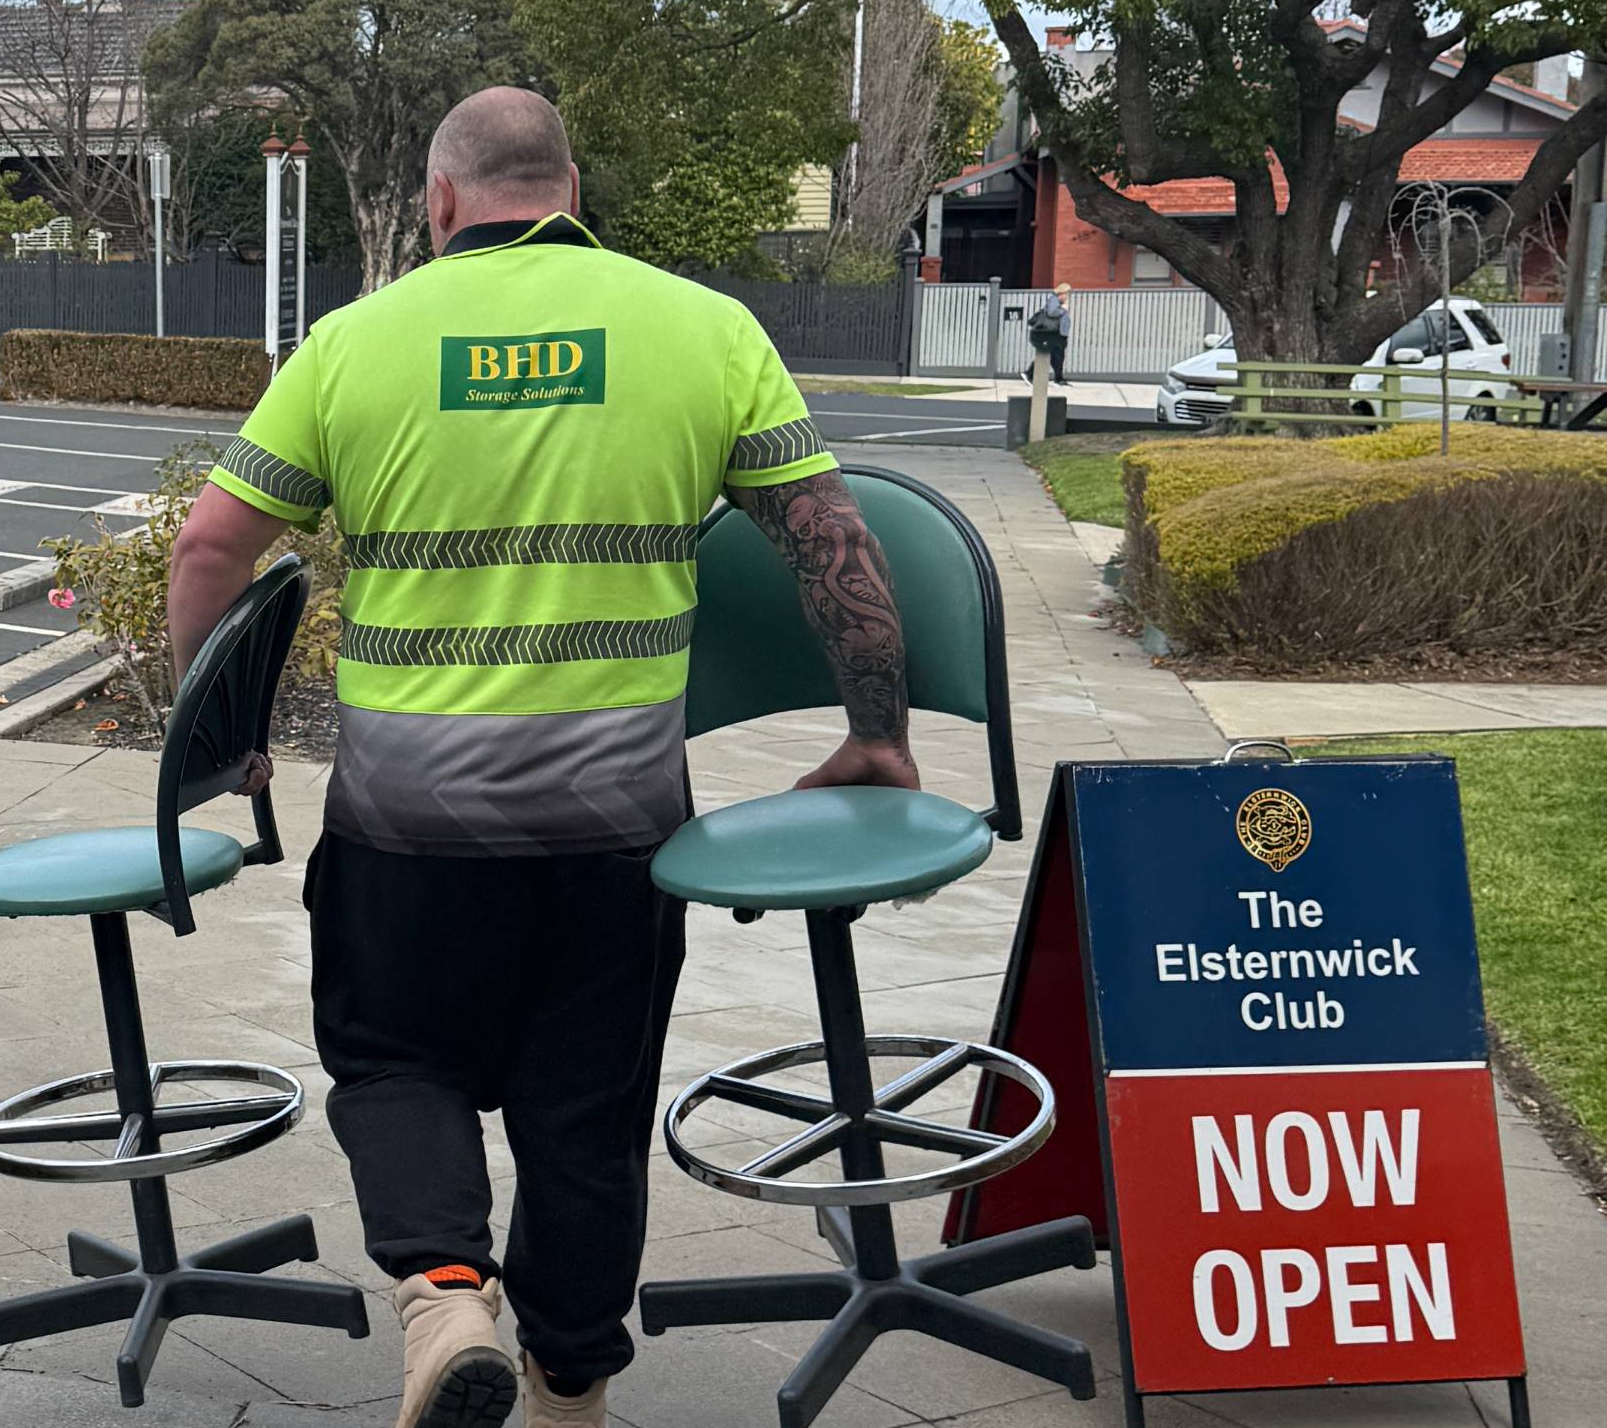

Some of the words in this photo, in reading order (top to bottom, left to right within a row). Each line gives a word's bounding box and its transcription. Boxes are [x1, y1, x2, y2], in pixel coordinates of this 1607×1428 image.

[466, 340, 584, 381] BHD
[465, 388, 519, 404] Storage
[520, 384, 586, 402] Solutions
[1237, 890, 1323, 929] The
[1155, 938, 1420, 982] Elsternwick
[1241, 990, 1345, 1031] Club
[1191, 1108, 1421, 1213] NOW
[1192, 1242, 1457, 1352] OPEN
